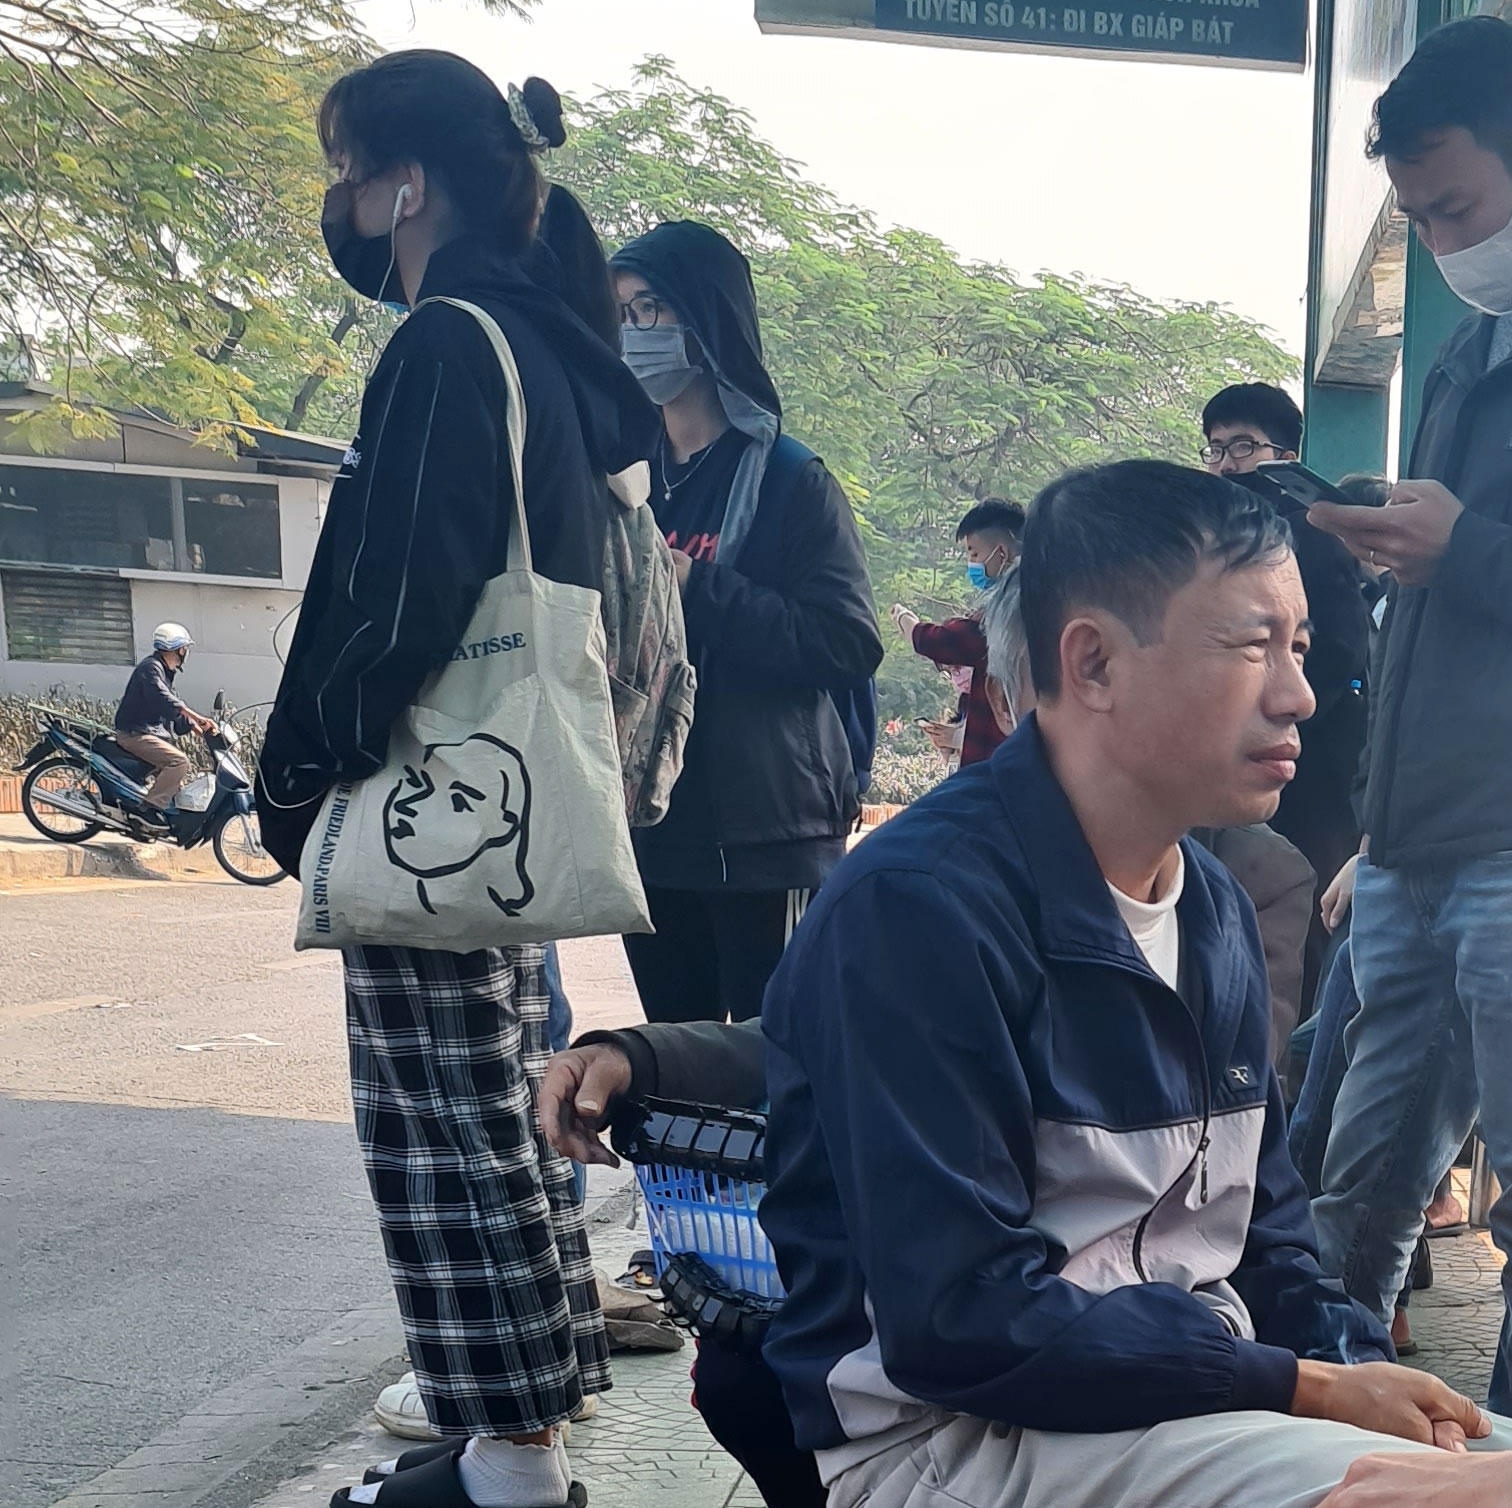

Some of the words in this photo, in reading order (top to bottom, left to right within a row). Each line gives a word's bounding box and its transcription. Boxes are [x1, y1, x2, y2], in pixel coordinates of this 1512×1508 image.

[1021, 6, 1056, 31] 41:
[1063, 8, 1086, 33] ĐI
[1093, 11, 1124, 36] BX
[1131, 11, 1185, 41] GIÁP
[1192, 16, 1235, 45] BÁT
[448, 632, 527, 661] ATISSE
